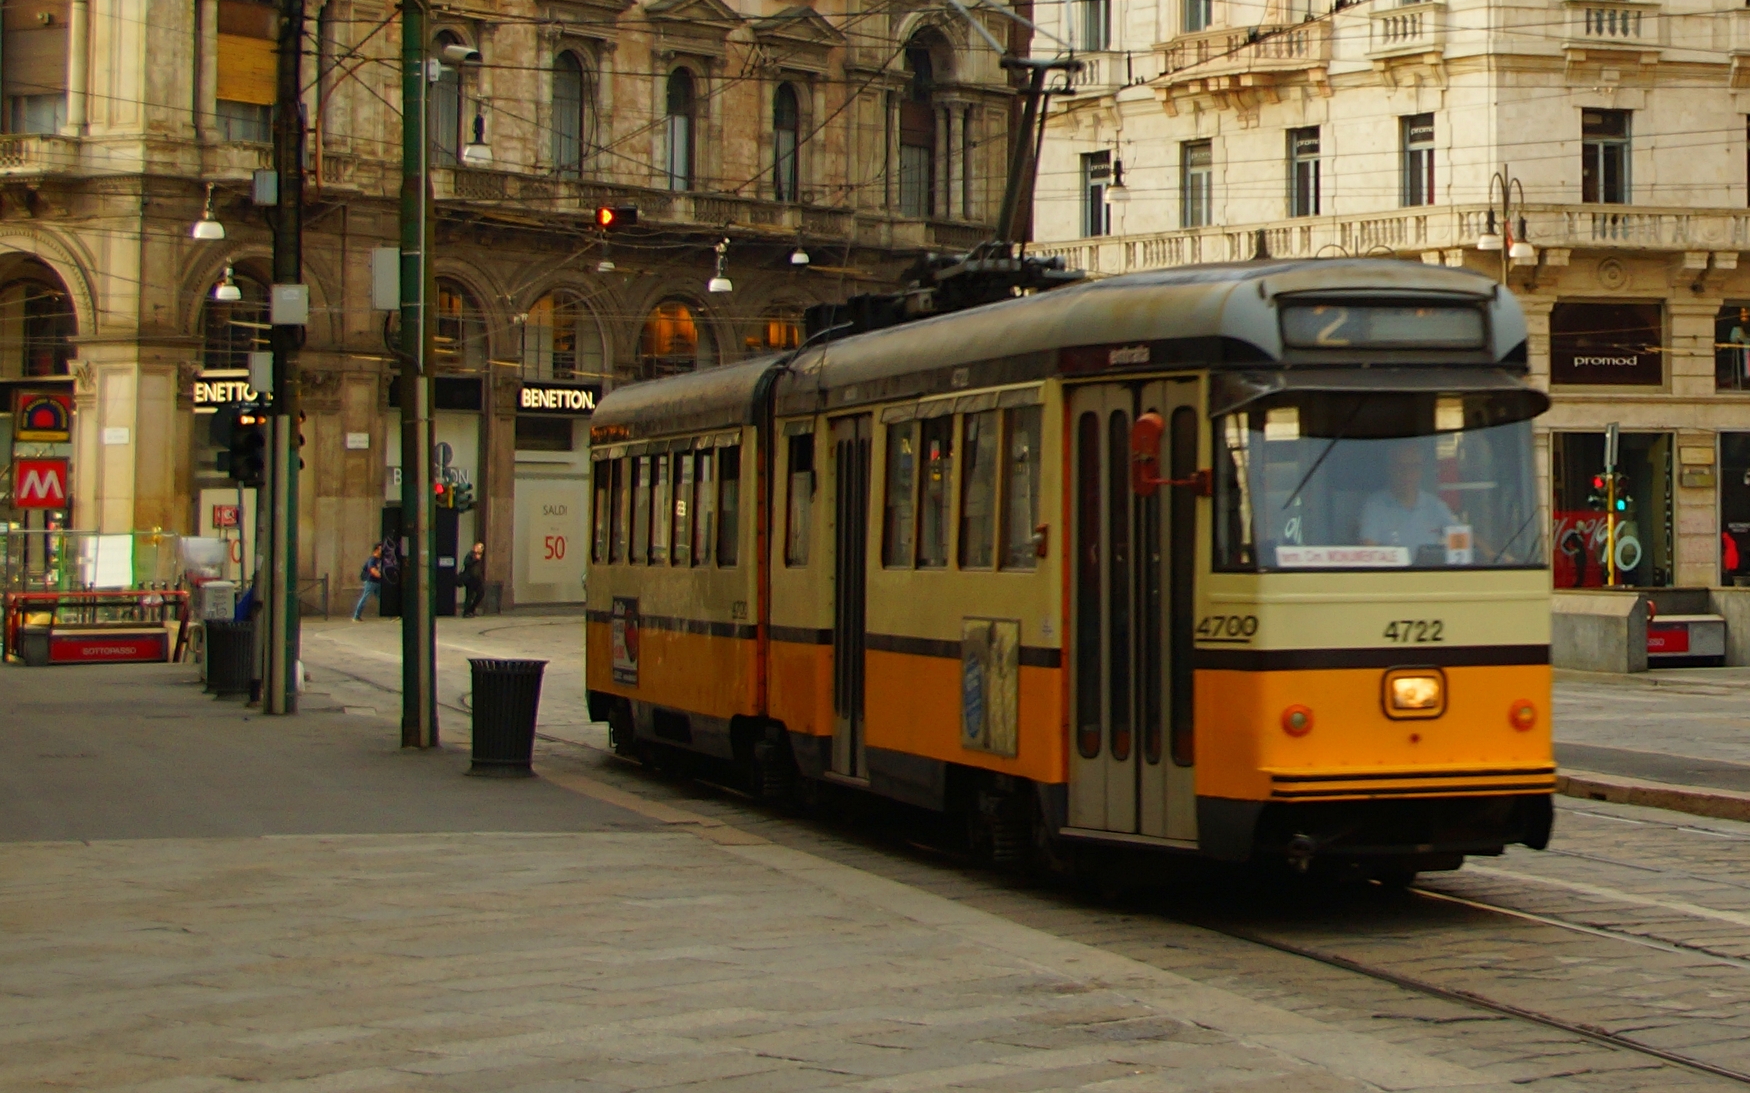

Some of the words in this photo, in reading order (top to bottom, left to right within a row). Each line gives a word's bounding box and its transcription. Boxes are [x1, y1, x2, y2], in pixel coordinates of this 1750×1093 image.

[1316, 309, 1351, 347] 2
[1573, 355, 1638, 368] promod
[20, 469, 64, 499] M
[542, 505, 568, 516] SALDI
[1195, 615, 1259, 638] 4700
[1383, 619, 1445, 643] 4722
[82, 646, 137, 656] SOTTOPASSO
